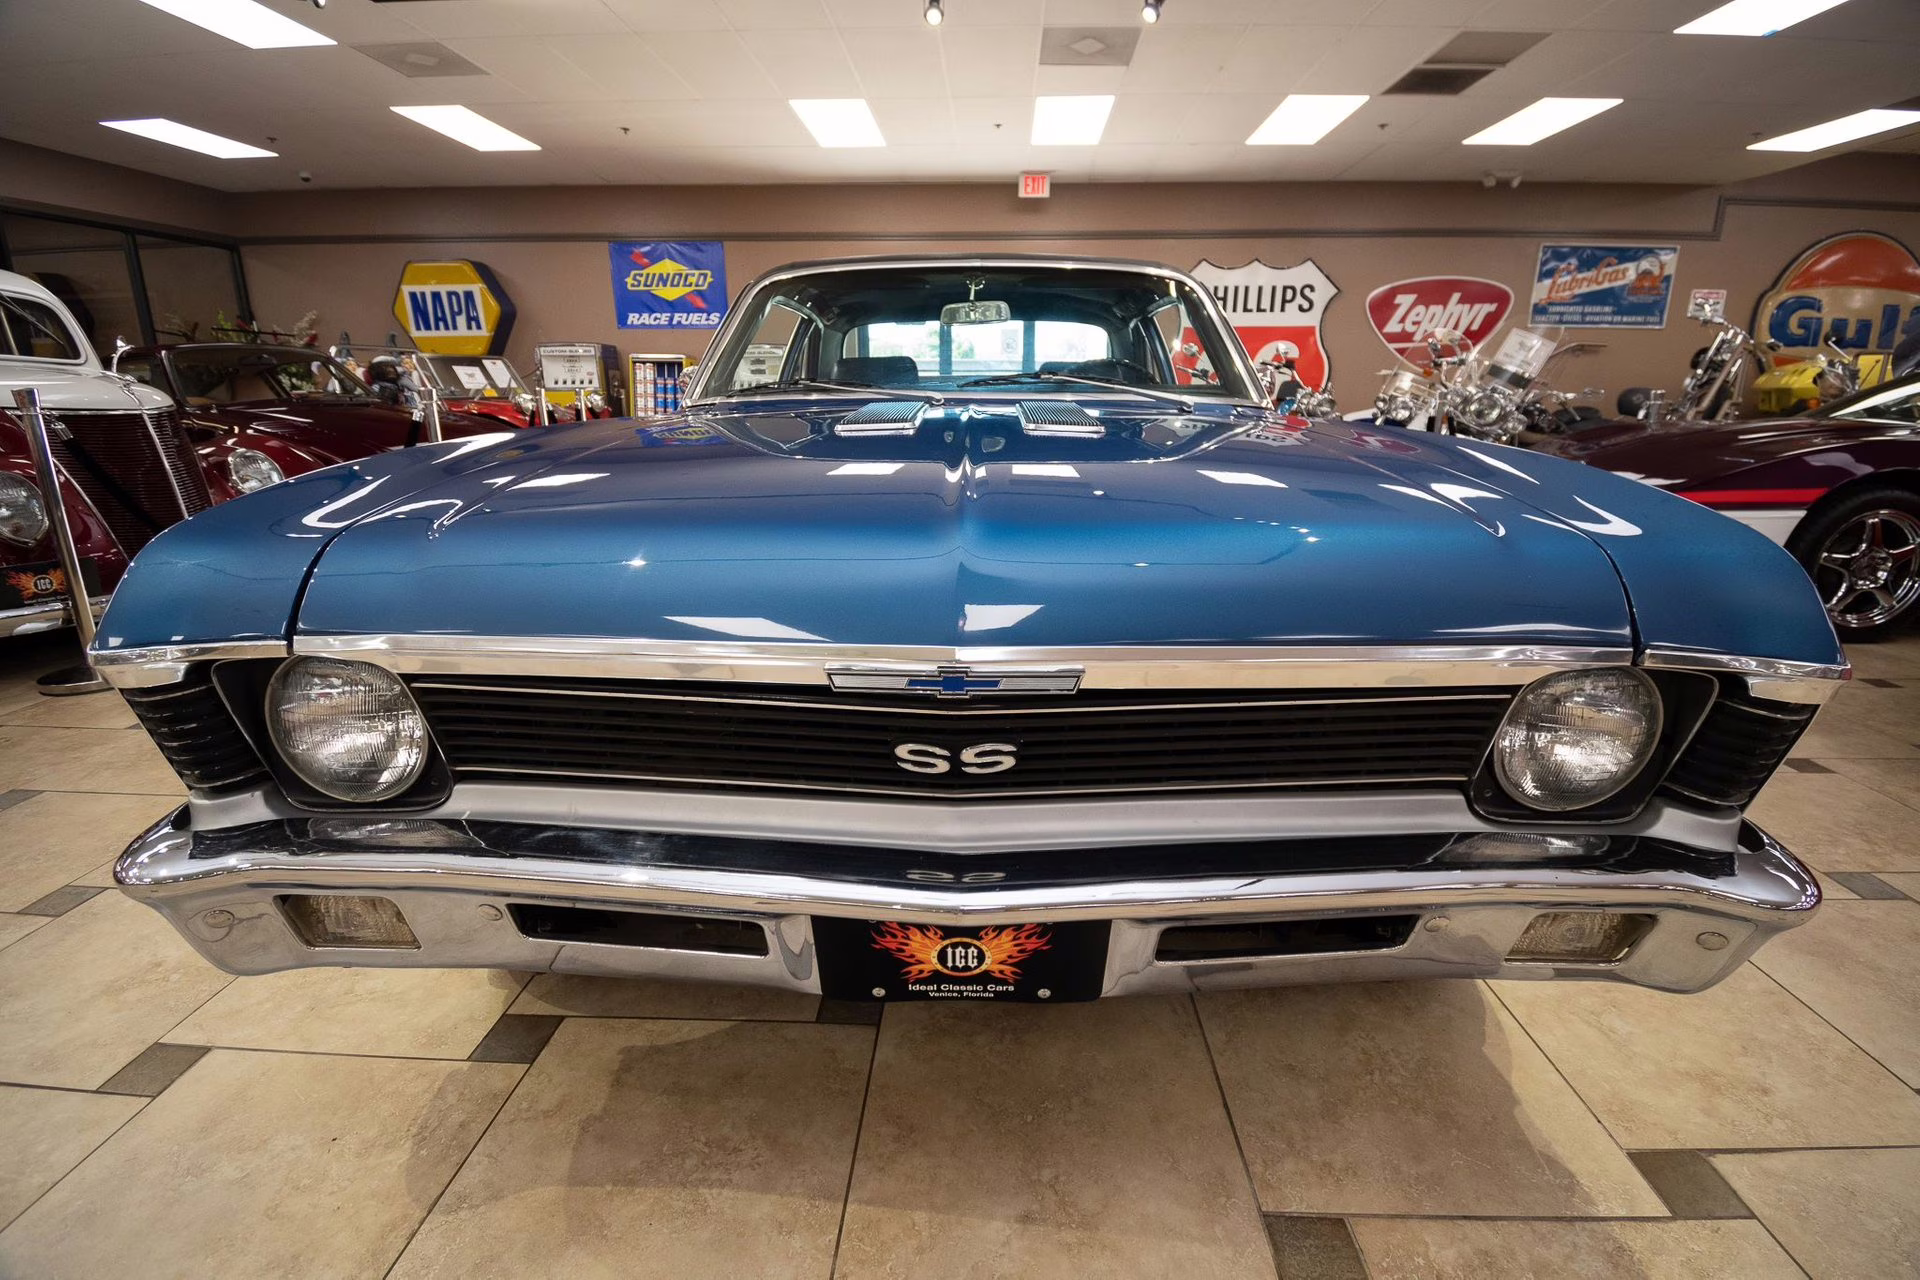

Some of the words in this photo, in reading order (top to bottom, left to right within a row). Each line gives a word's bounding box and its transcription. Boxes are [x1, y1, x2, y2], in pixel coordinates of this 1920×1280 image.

[1023, 175, 1047, 195] EXIT
[629, 272, 709, 288] SUNOCO
[408, 290, 482, 331] NAPA
[1212, 284, 1316, 313] HILLIPS
[627, 313, 670, 325] RACE
[672, 313, 720, 325] FUELS
[1382, 292, 1498, 342] Zephyr
[1769, 296, 1920, 349] Gul
[894, 743, 1017, 774] SS
[987, 984, 1015, 992] Cars
